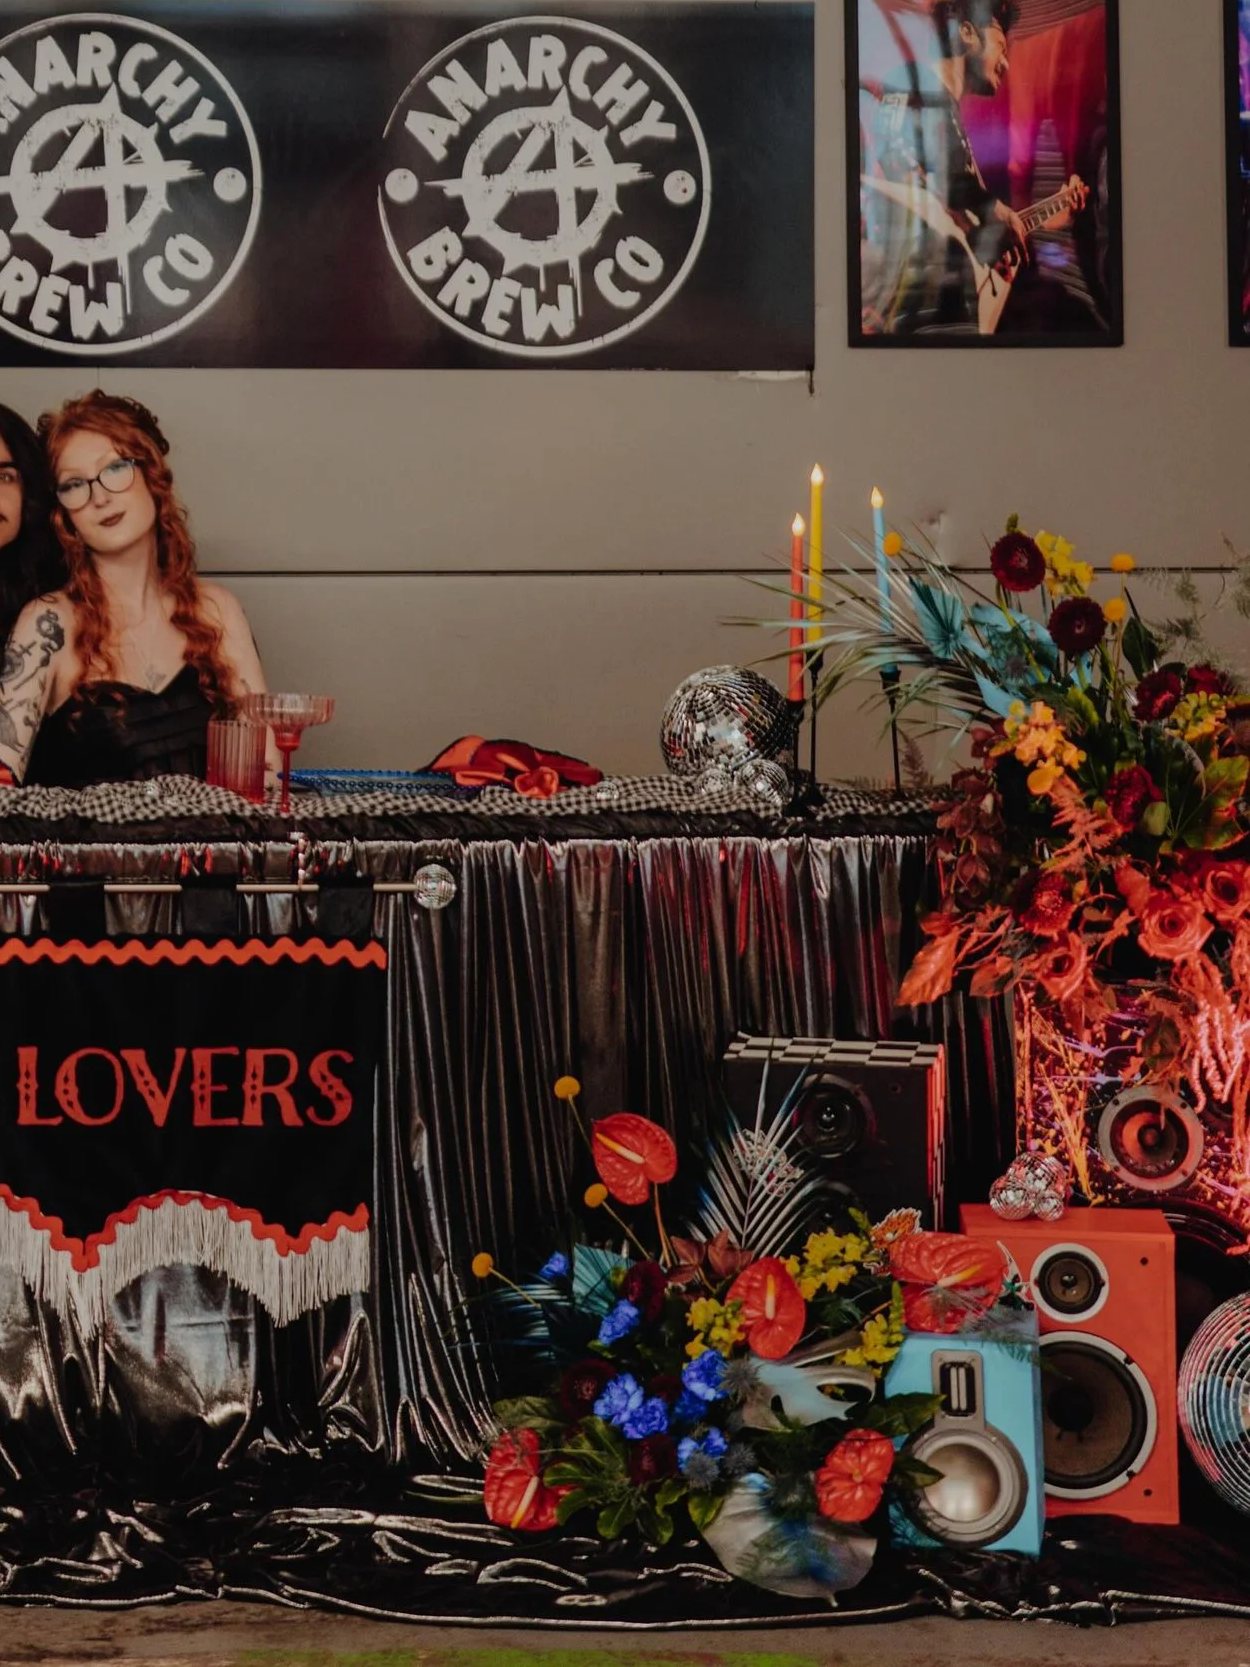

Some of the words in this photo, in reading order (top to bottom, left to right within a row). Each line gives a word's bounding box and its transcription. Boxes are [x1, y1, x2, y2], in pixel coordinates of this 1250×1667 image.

[404, 34, 677, 163] ANARCHY
[143, 233, 214, 307] CO
[406, 226, 576, 342] BREW
[594, 235, 664, 310] CO
[17, 1046, 354, 1128] LOVERS
